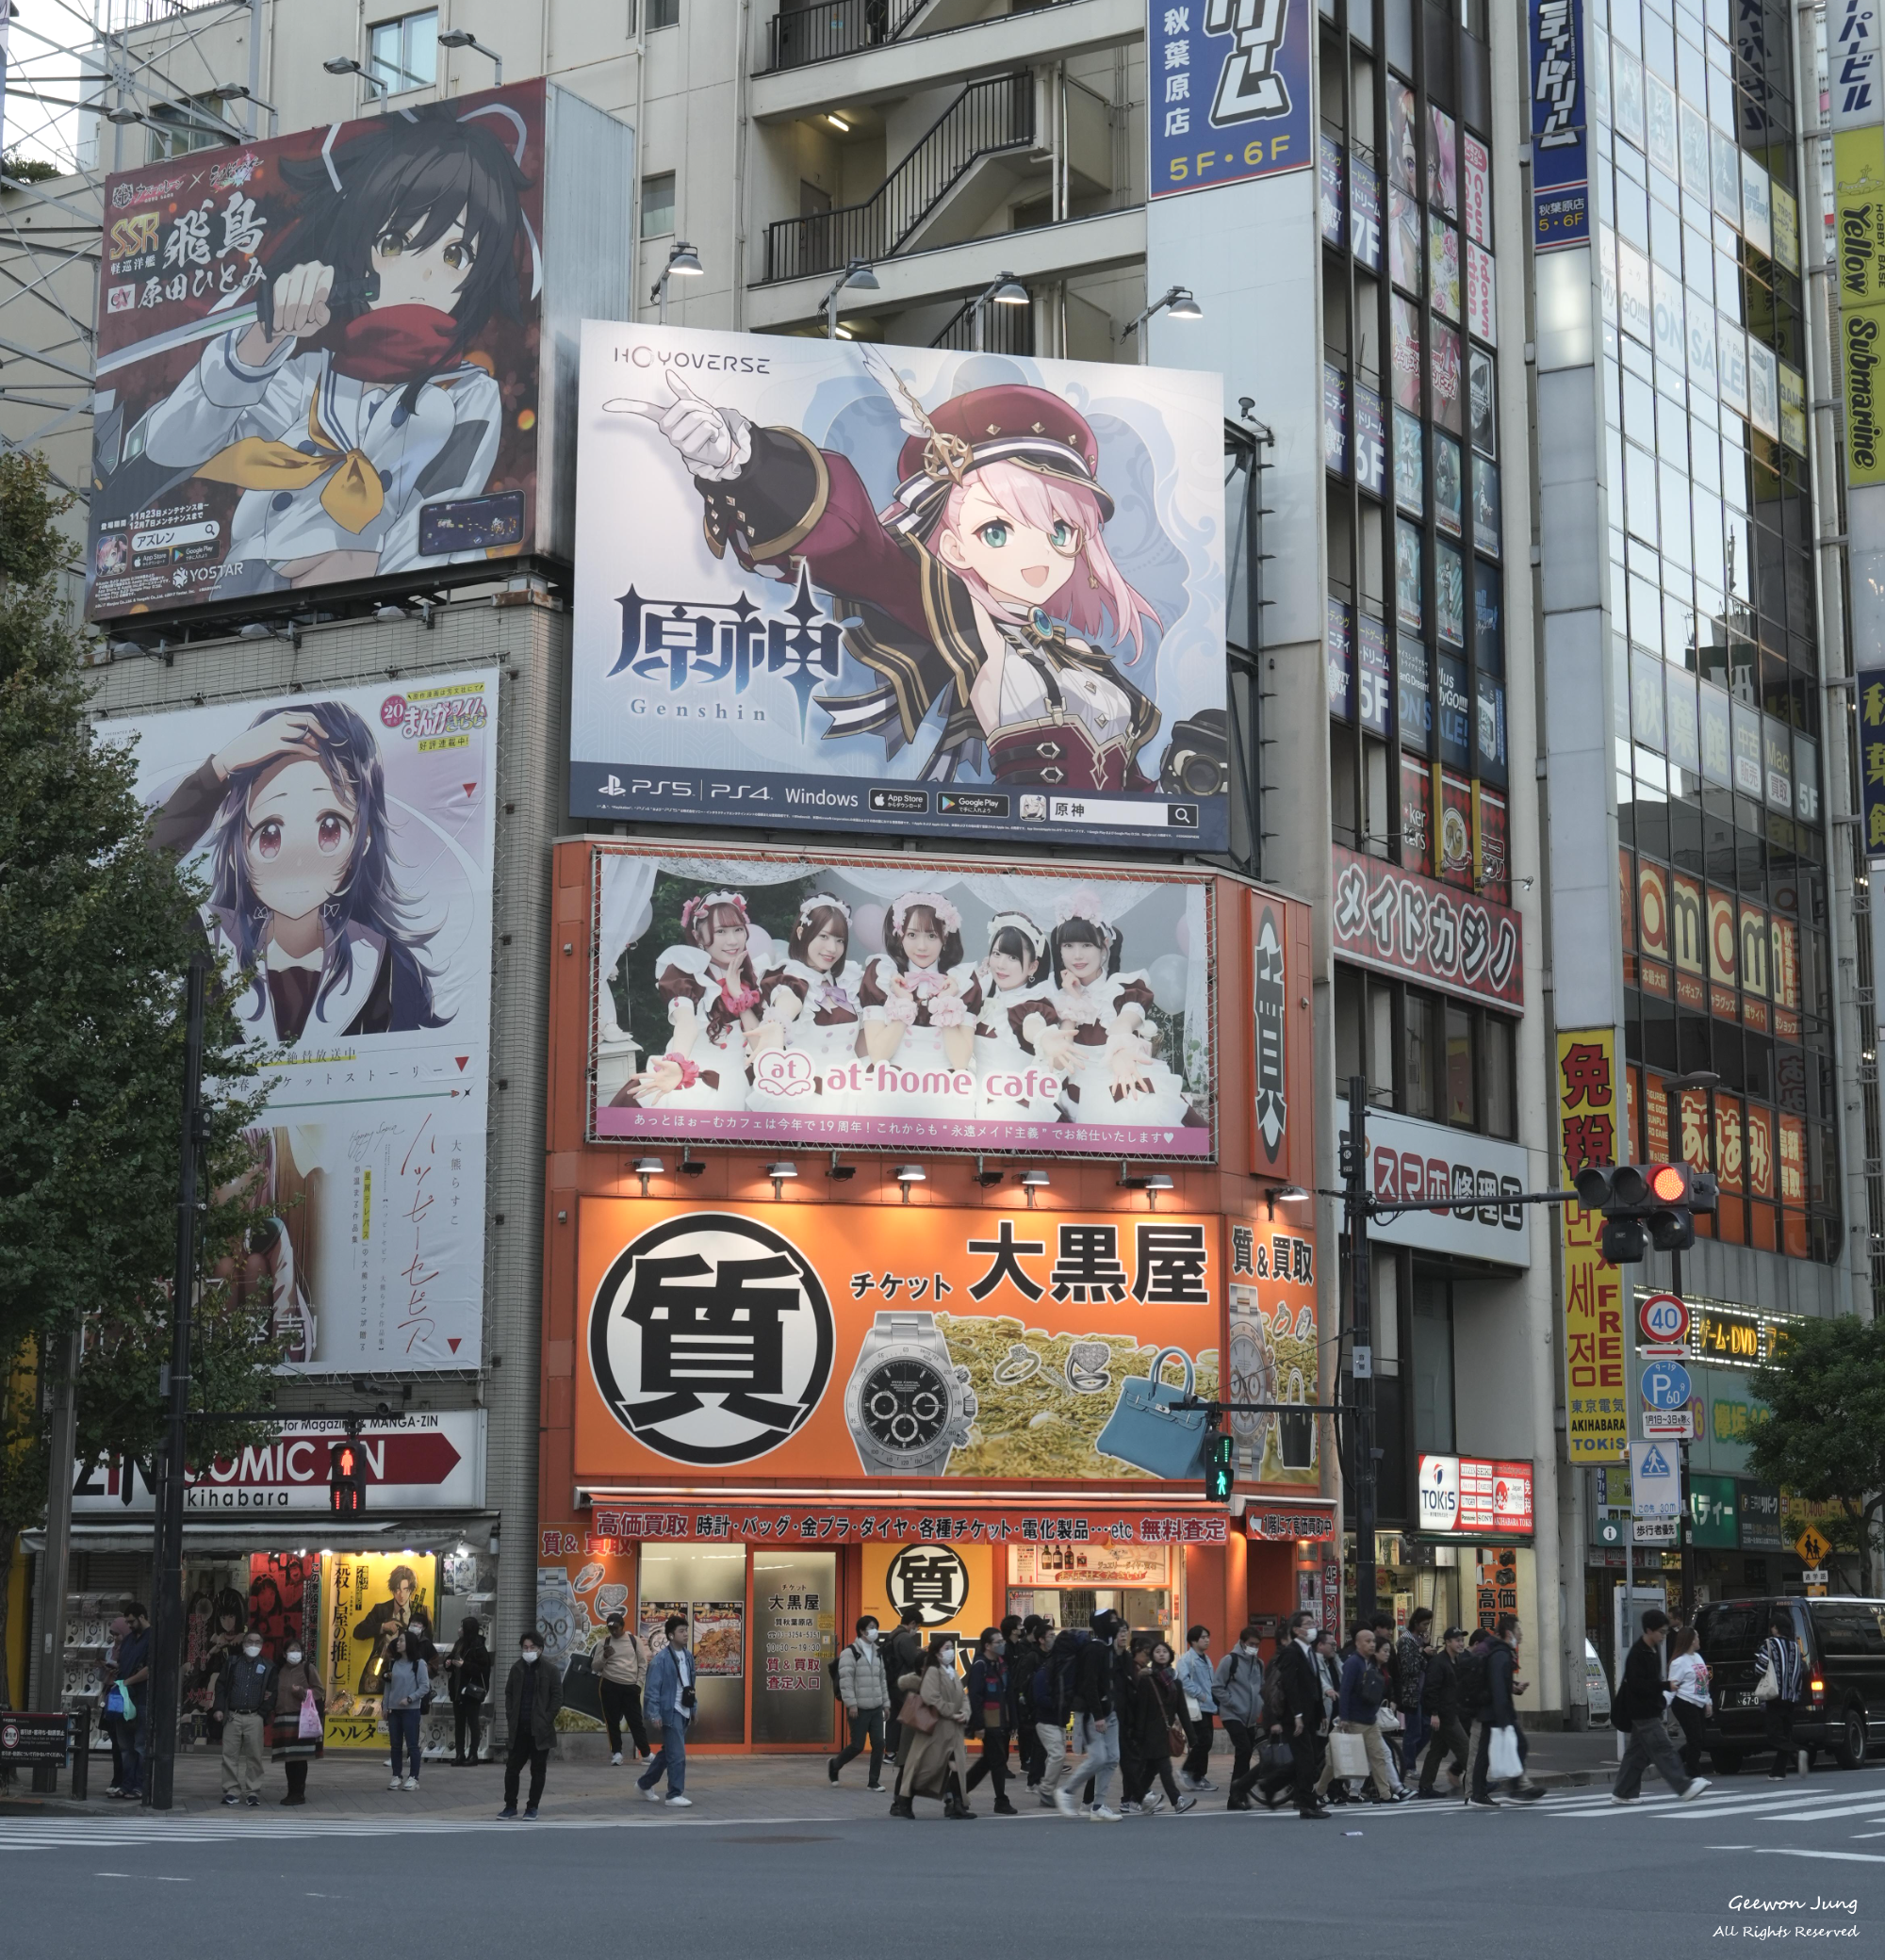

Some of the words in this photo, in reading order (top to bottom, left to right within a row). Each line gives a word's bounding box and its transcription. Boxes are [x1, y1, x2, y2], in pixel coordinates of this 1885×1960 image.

[1164, 6, 1190, 138] 秋葉原店
[1352, 188, 1381, 219] ドリーム
[1538, 198, 1584, 216] 秋葉原店
[109, 211, 160, 260] SSR
[162, 190, 268, 270] 飛鳥
[1352, 208, 1380, 265] 7F
[1876, 204, 1884, 248] HOBBY
[110, 255, 156, 275] 軽巡洋艦
[1840, 202, 1874, 298] Yellow
[138, 256, 268, 309] 原田ひとみ
[110, 290, 132, 308] CV
[615, 345, 771, 375] HOYOVERSE
[1653, 302, 1684, 356] ON
[1690, 328, 1746, 402] SALE!
[1779, 381, 1805, 414] GAME
[1845, 314, 1883, 471] Submarine
[1355, 410, 1385, 438] ドリーム
[1355, 433, 1385, 488] 6F
[137, 532, 175, 548] アズレン
[189, 563, 244, 582] YOSTAR
[606, 556, 847, 745] 原神
[1359, 645, 1389, 672] ドリーム
[384, 704, 403, 719] 20
[630, 696, 768, 723] Genshin
[1360, 669, 1389, 724] 5F
[1737, 725, 1760, 761] 中古
[1765, 738, 1790, 775] Mac
[631, 779, 693, 797] PS5
[711, 783, 771, 801] PS4
[785, 788, 860, 808] Windows
[1740, 762, 1760, 788] 販売
[1769, 775, 1789, 802] 買取
[888, 793, 904, 804] App
[905, 794, 924, 804] Store
[959, 797, 983, 808] Google
[984, 798, 999, 809] Play
[1055, 802, 1085, 818] 原神
[1798, 782, 1819, 820] 5F
[1335, 862, 1516, 992] メイドカジノ
[1640, 869, 1785, 1005] amami
[771, 1059, 797, 1079] at
[827, 1062, 974, 1096] at-home
[986, 1070, 1058, 1099] cafe
[1561, 1043, 1615, 1181] 免税
[1779, 1127, 1799, 1162] 高額
[451, 1139, 462, 1225] 大熊らすこ
[1375, 1150, 1523, 1229] スマホ修理王
[850, 1271, 954, 1302] チケット
[967, 1220, 1210, 1306] 大黒屋
[1231, 1224, 1315, 1287] 質&買取
[1651, 1308, 1679, 1330] 40
[615, 1251, 808, 1434] 質
[1598, 1284, 1623, 1387] FREE
[1655, 1363, 1677, 1372] 9-19
[1652, 1374, 1671, 1404] P
[1666, 1391, 1680, 1404] 60
[1571, 1398, 1625, 1413] 東京電気
[283, 1419, 299, 1431] for
[301, 1417, 350, 1431] Magazi
[1571, 1419, 1626, 1432] AKIHABARA
[1573, 1437, 1626, 1451] TOKiS
[188, 1488, 290, 1509] kihabara
[1524, 1478, 1533, 1514] 免税
[1638, 1504, 1655, 1513] この先
[1660, 1503, 1677, 1513] 30m
[597, 1511, 688, 1538] 高価買取
[1139, 1518, 1227, 1542] 無料査定
[1264, 1513, 1333, 1537] 1階にて高価買取中
[1636, 1522, 1676, 1537] 歩行者優先
[781, 1584, 807, 1592] チケット
[893, 1552, 962, 1618] 質
[1325, 1565, 1337, 1584] 4F
[768, 1593, 821, 1610] 大黒屋
[1477, 1588, 1517, 1610] 高価
[775, 1618, 813, 1627] 質秋葉原店
[766, 1675, 821, 1690] 査定入口
[326, 1723, 377, 1743] ハルタ
